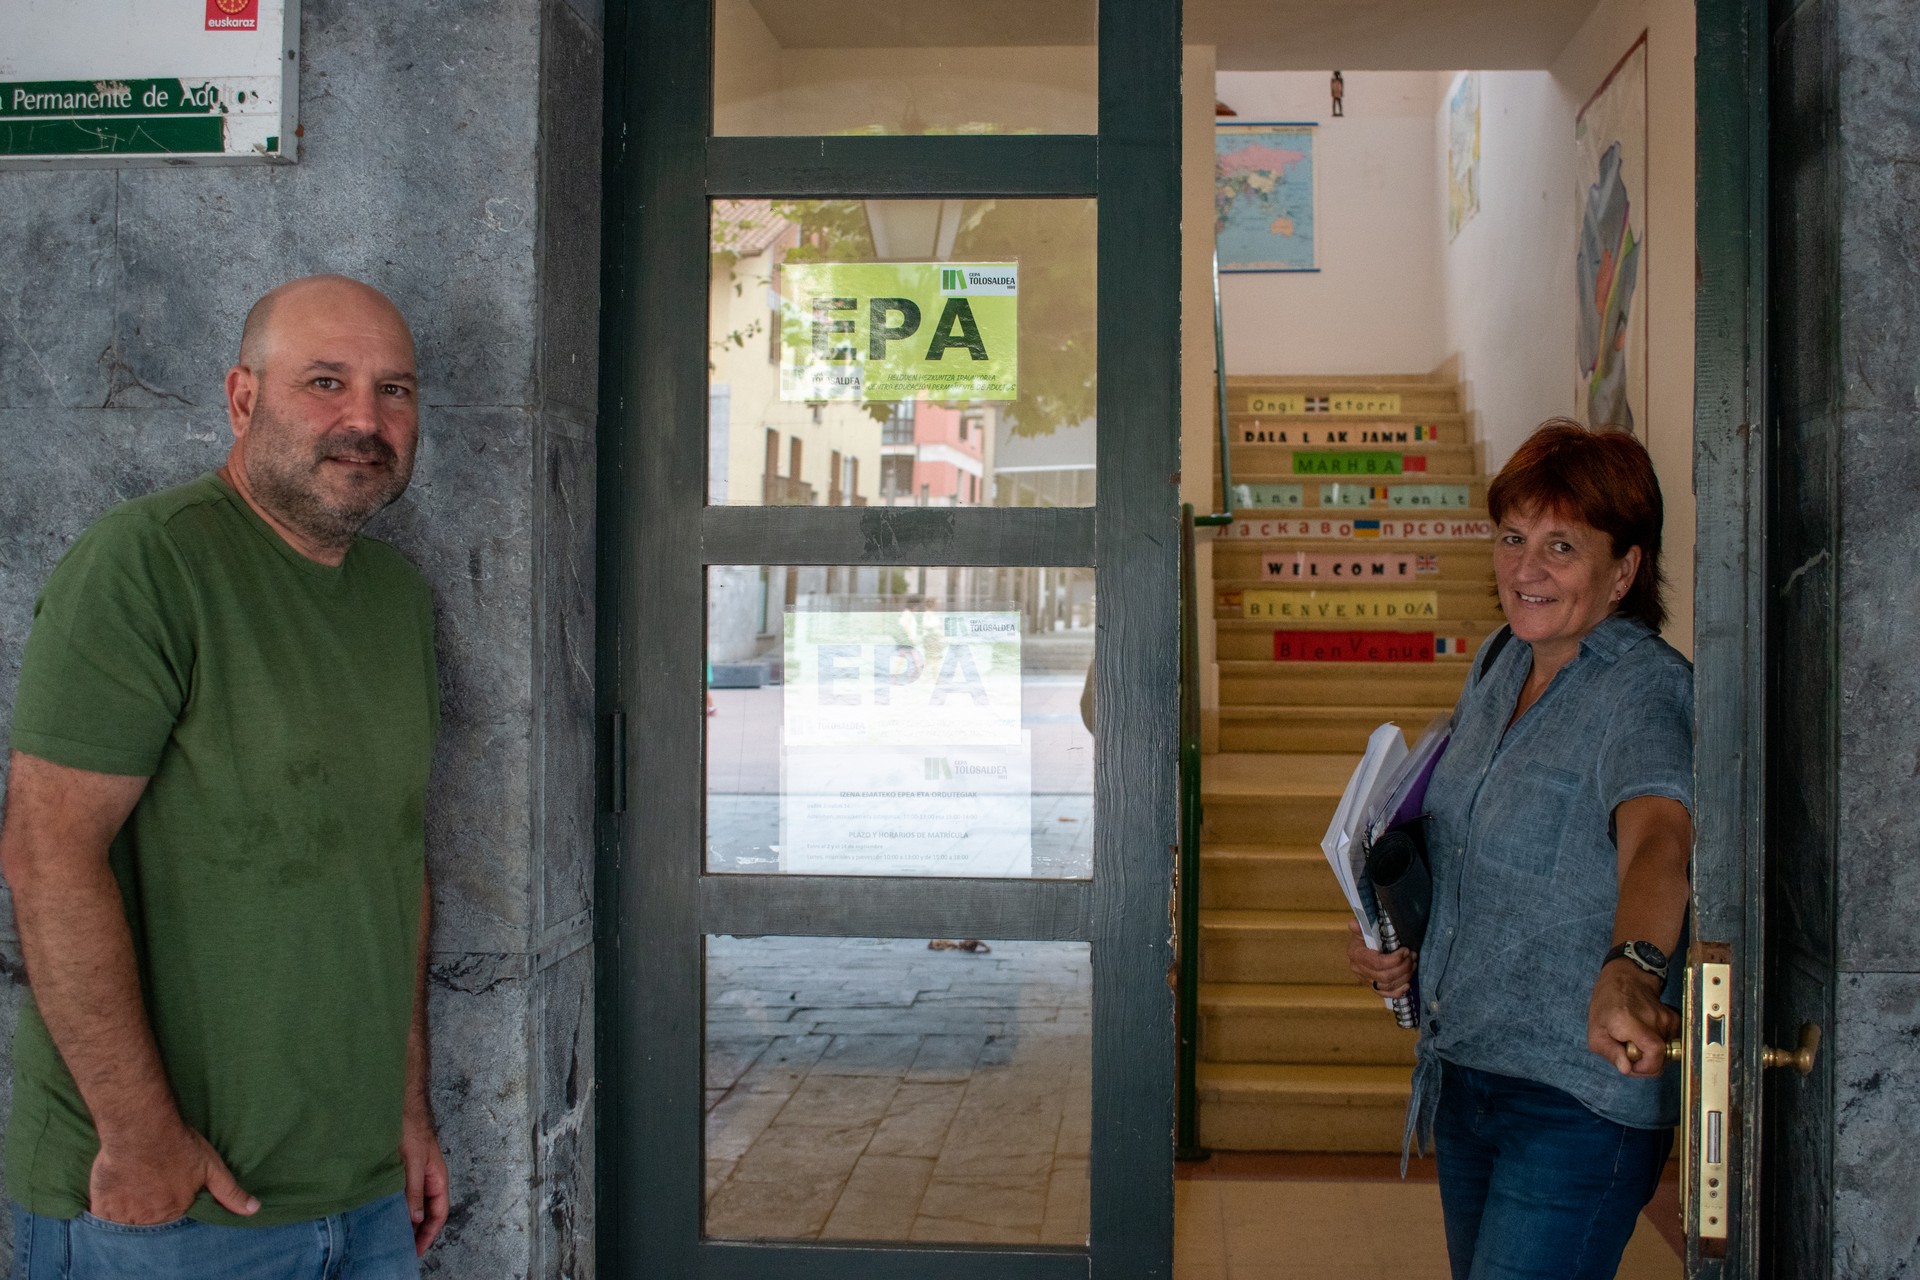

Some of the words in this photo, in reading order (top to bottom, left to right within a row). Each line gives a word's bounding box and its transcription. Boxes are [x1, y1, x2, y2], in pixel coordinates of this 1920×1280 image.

[208, 17, 255, 28] euskaraz
[13, 88, 132, 110] Permanente
[142, 84, 169, 107] de
[969, 277, 1016, 285] TOLOSALDEA
[811, 297, 989, 360] EPA
[1252, 400, 1296, 414] Ongi
[1334, 399, 1395, 411] etorri
[1327, 431, 1348, 443] AK
[1361, 431, 1408, 443] JAMM
[1298, 459, 1395, 473] MARHBA
[1393, 494, 1467, 505] venit
[1267, 562, 1407, 576] WELCOME
[1250, 603, 1434, 617] BIENVENIDO/A
[970, 624, 1015, 632] TOLOSALDEA
[817, 645, 989, 706] EPA
[955, 765, 1007, 774] TOLOSALDEA
[879, 831, 915, 839] HORARIOS
[927, 830, 968, 839] MATRÍCULA
